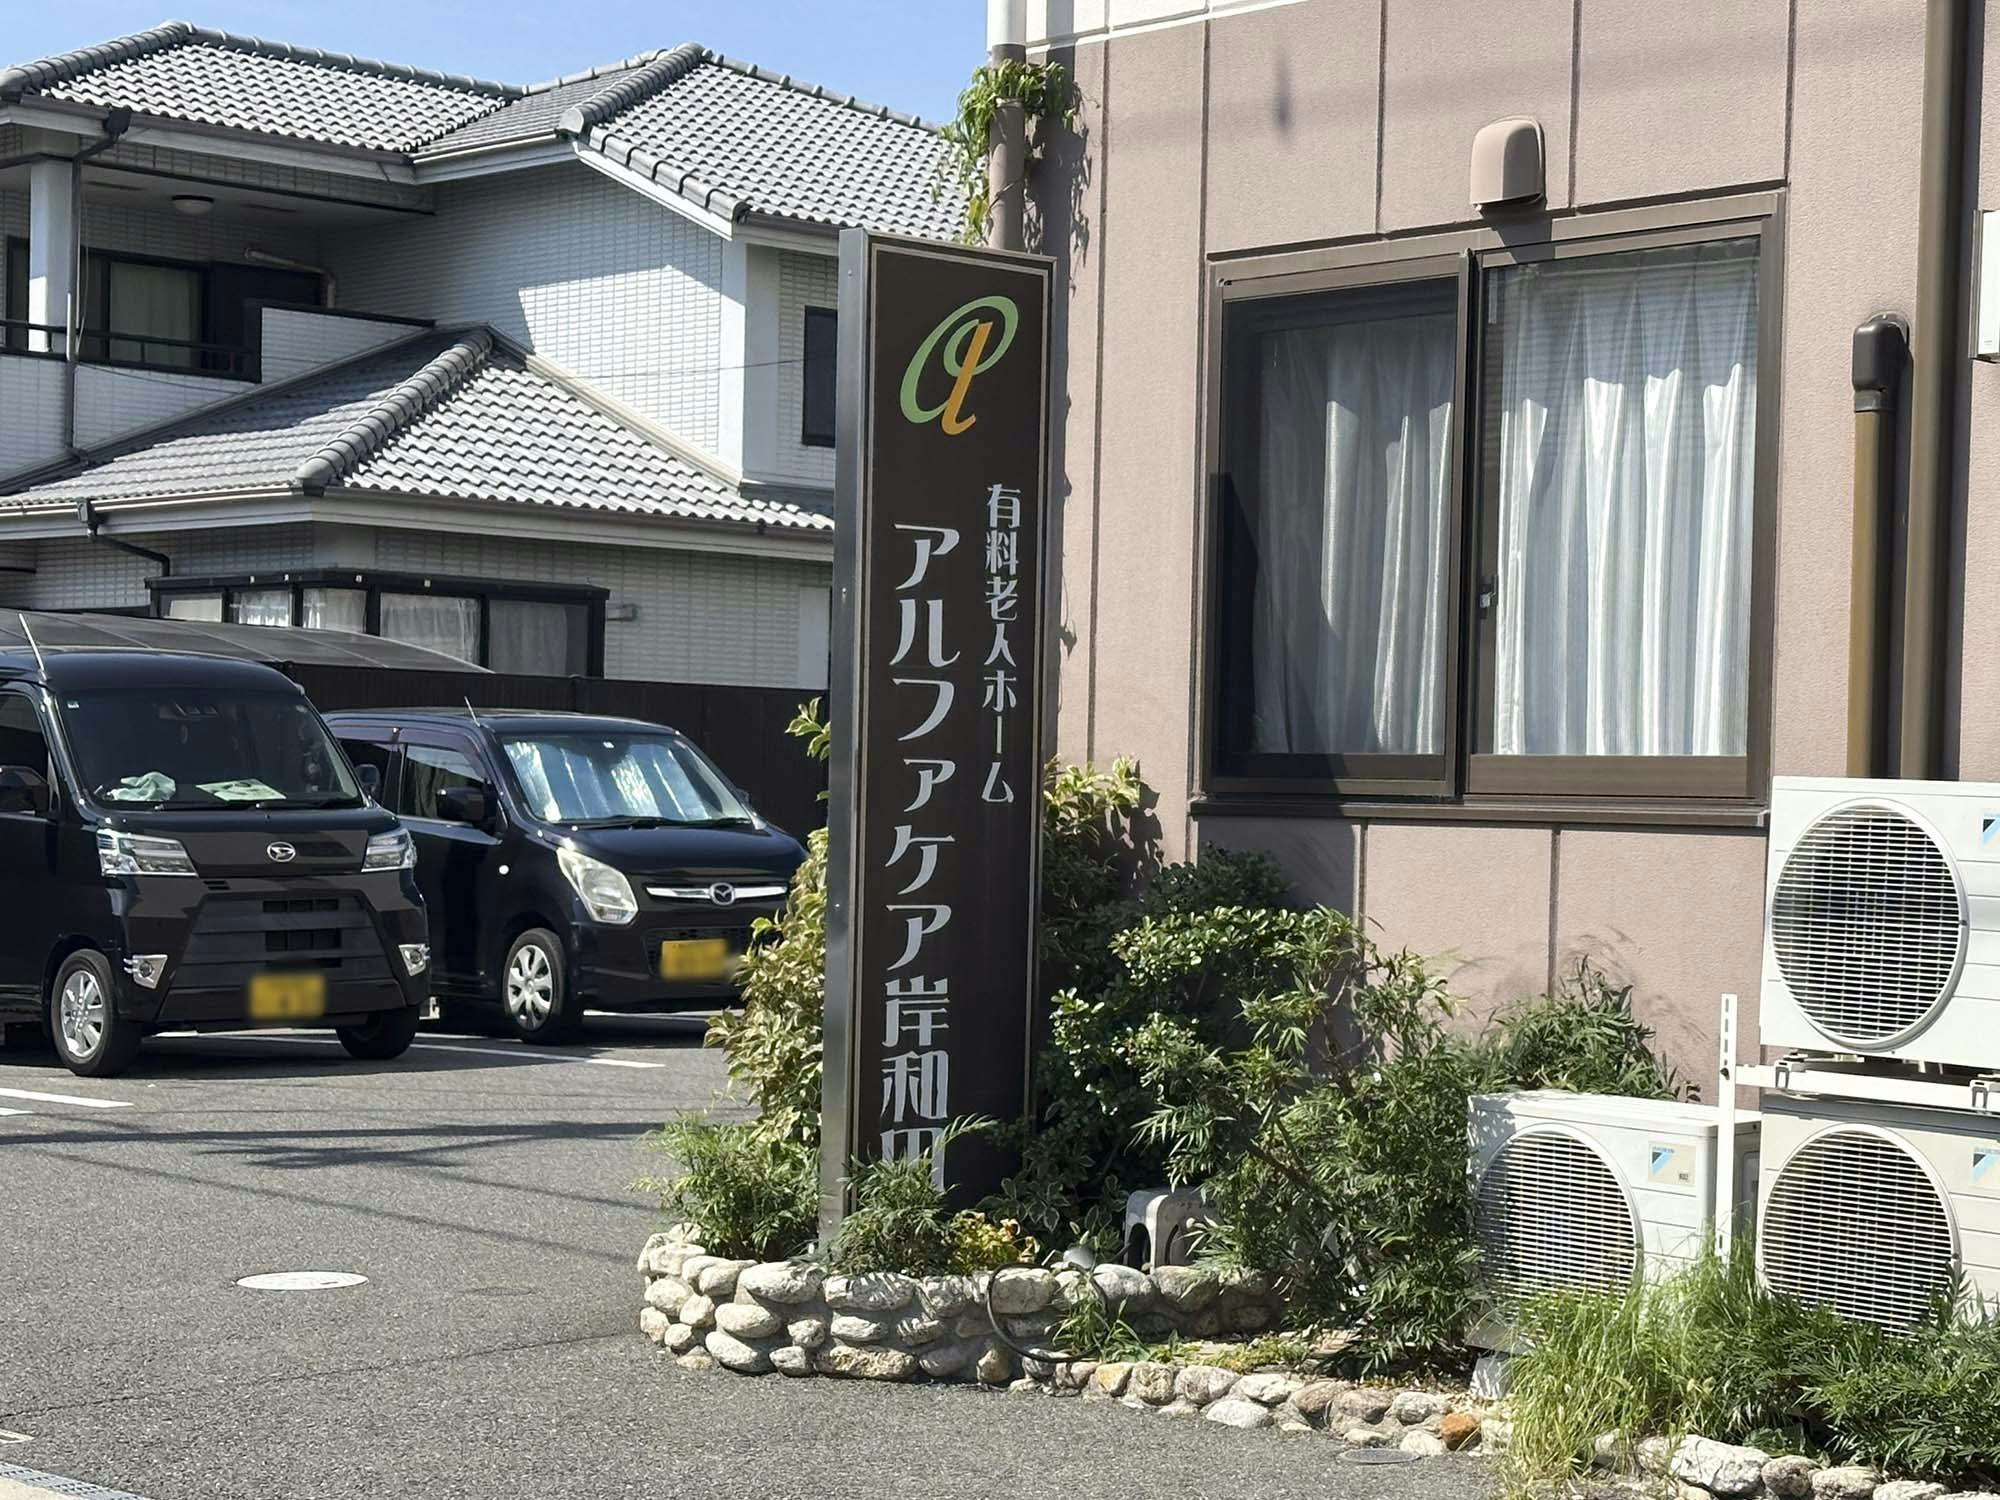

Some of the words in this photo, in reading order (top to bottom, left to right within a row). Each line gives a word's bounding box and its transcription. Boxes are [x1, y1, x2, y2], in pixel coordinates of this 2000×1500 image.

[981, 483, 1020, 804] 有料老人ホーム
